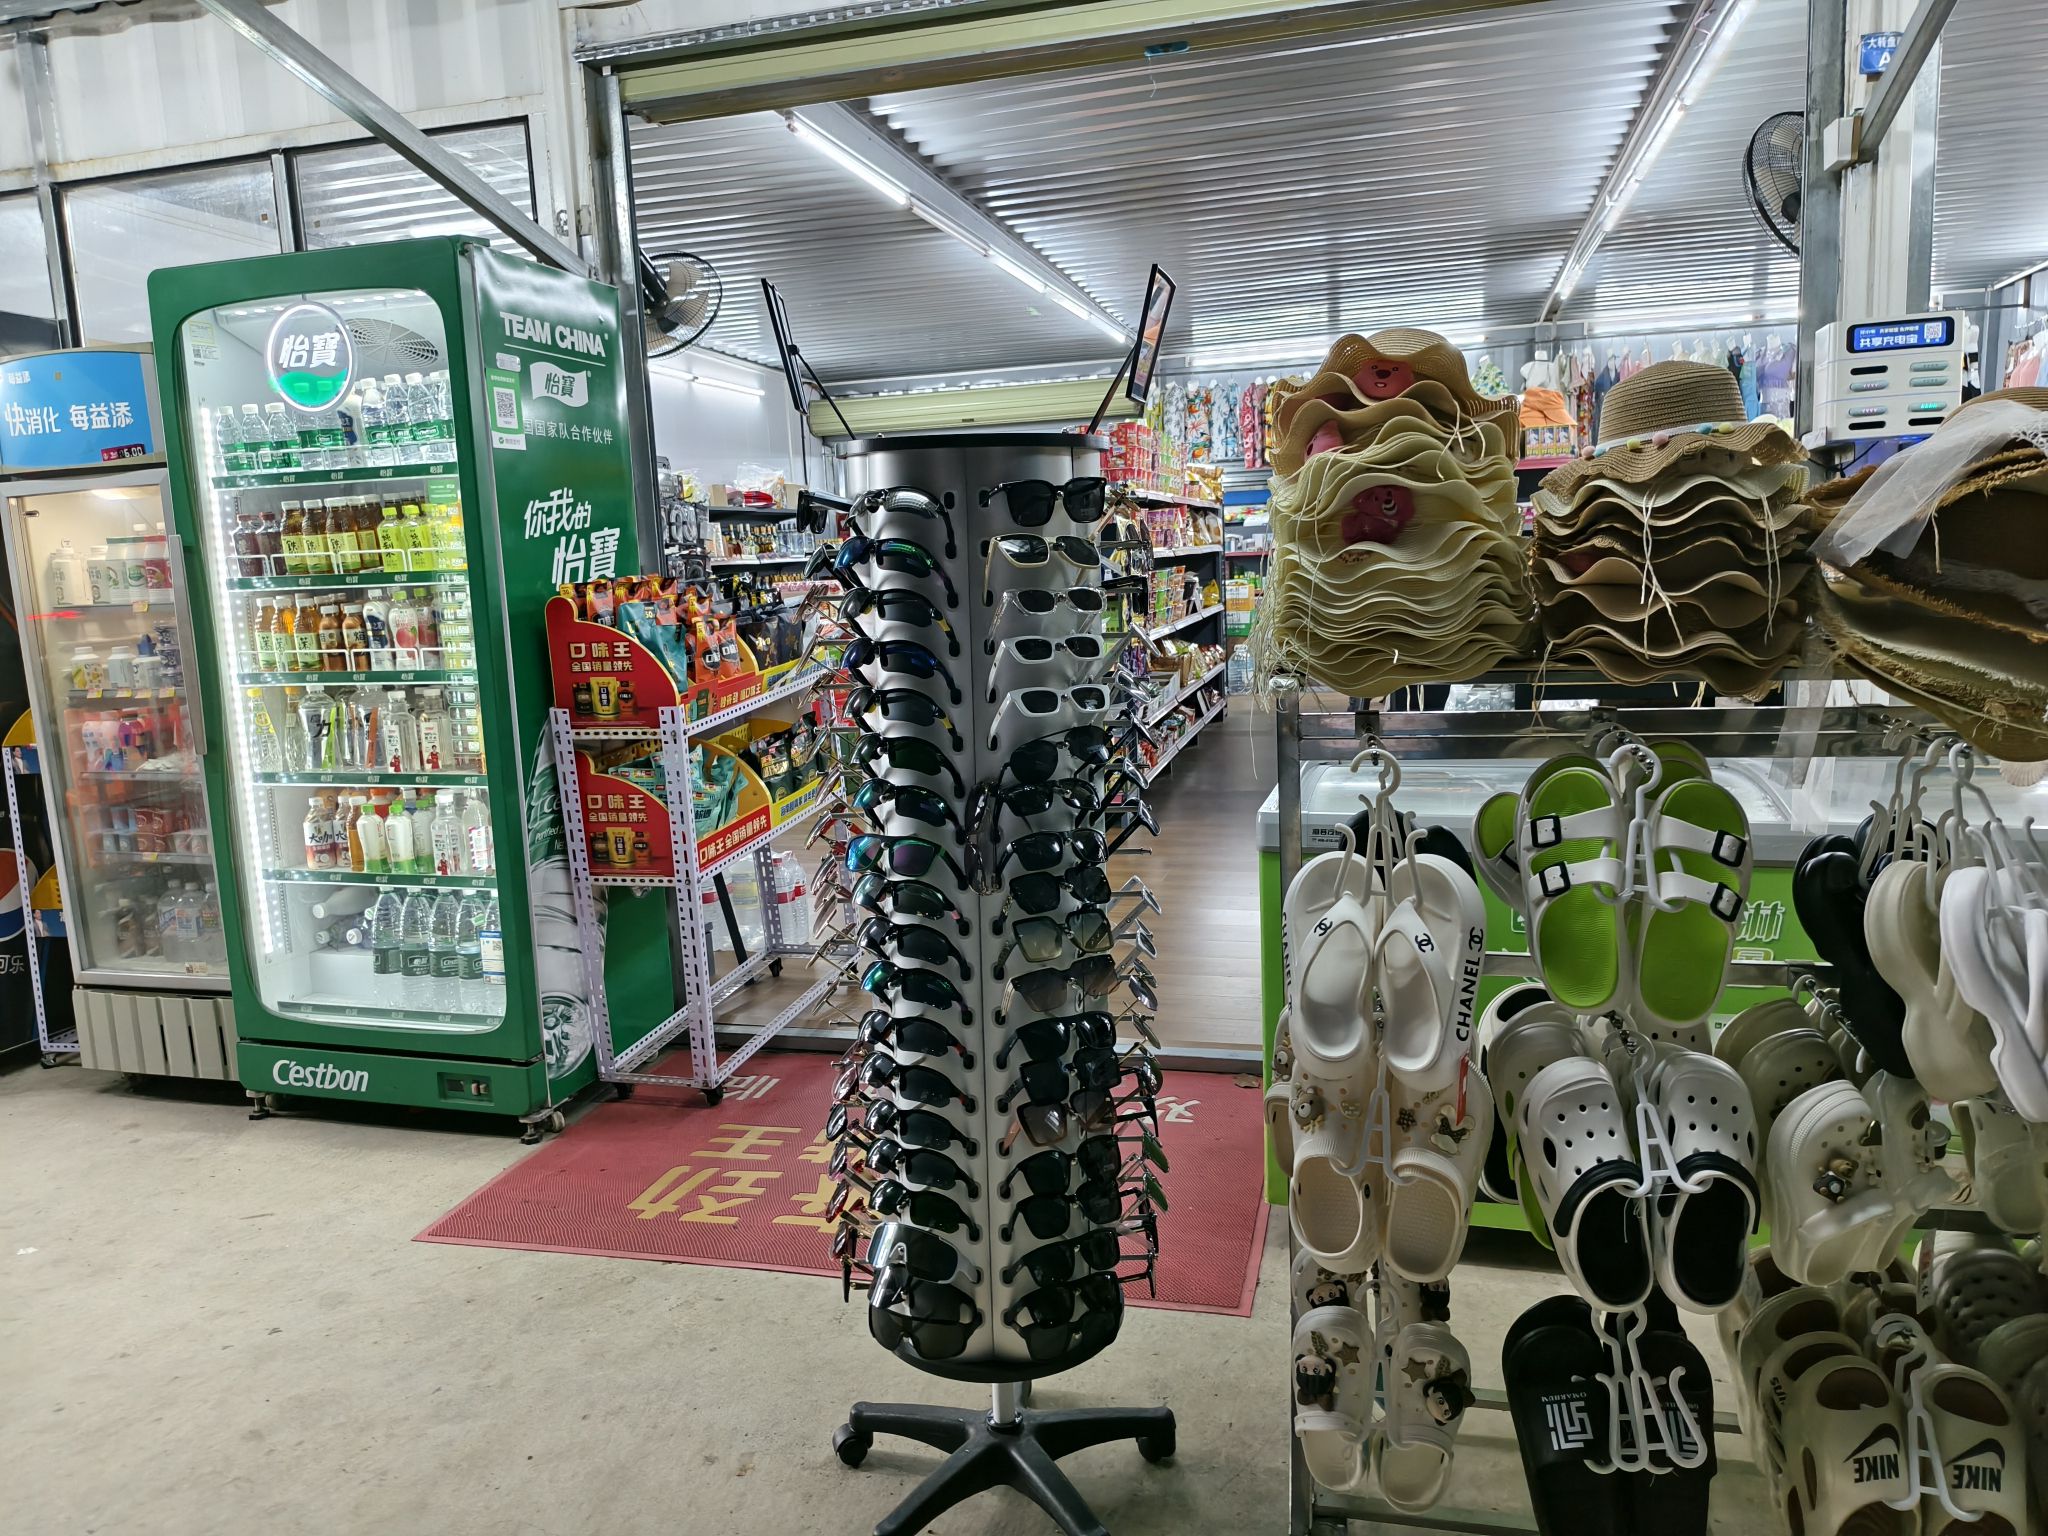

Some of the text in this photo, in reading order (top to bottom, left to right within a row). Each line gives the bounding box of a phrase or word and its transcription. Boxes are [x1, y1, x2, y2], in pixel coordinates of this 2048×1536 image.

[500, 311, 606, 357] TEAM CHINA
[1859, 334, 1918, 348] 共享充电宝
[279, 332, 341, 369] 怡寶
[544, 372, 576, 398] 怡寶
[4, 401, 134, 437] 快消化 每益添
[523, 486, 592, 540] 你我的
[569, 641, 632, 659] 口味王
[571, 660, 634, 673] 全国销量领先
[587, 794, 647, 810] 口味王
[588, 812, 649, 823] 全国销量领先
[699, 813, 768, 864] 口味王 全国销量领先
[1456, 957, 1481, 1042] CHANEL
[272, 1059, 369, 1092] C'estbon
[1853, 1453, 1900, 1484] NIKE
[1952, 1464, 2001, 1493] NIKE
